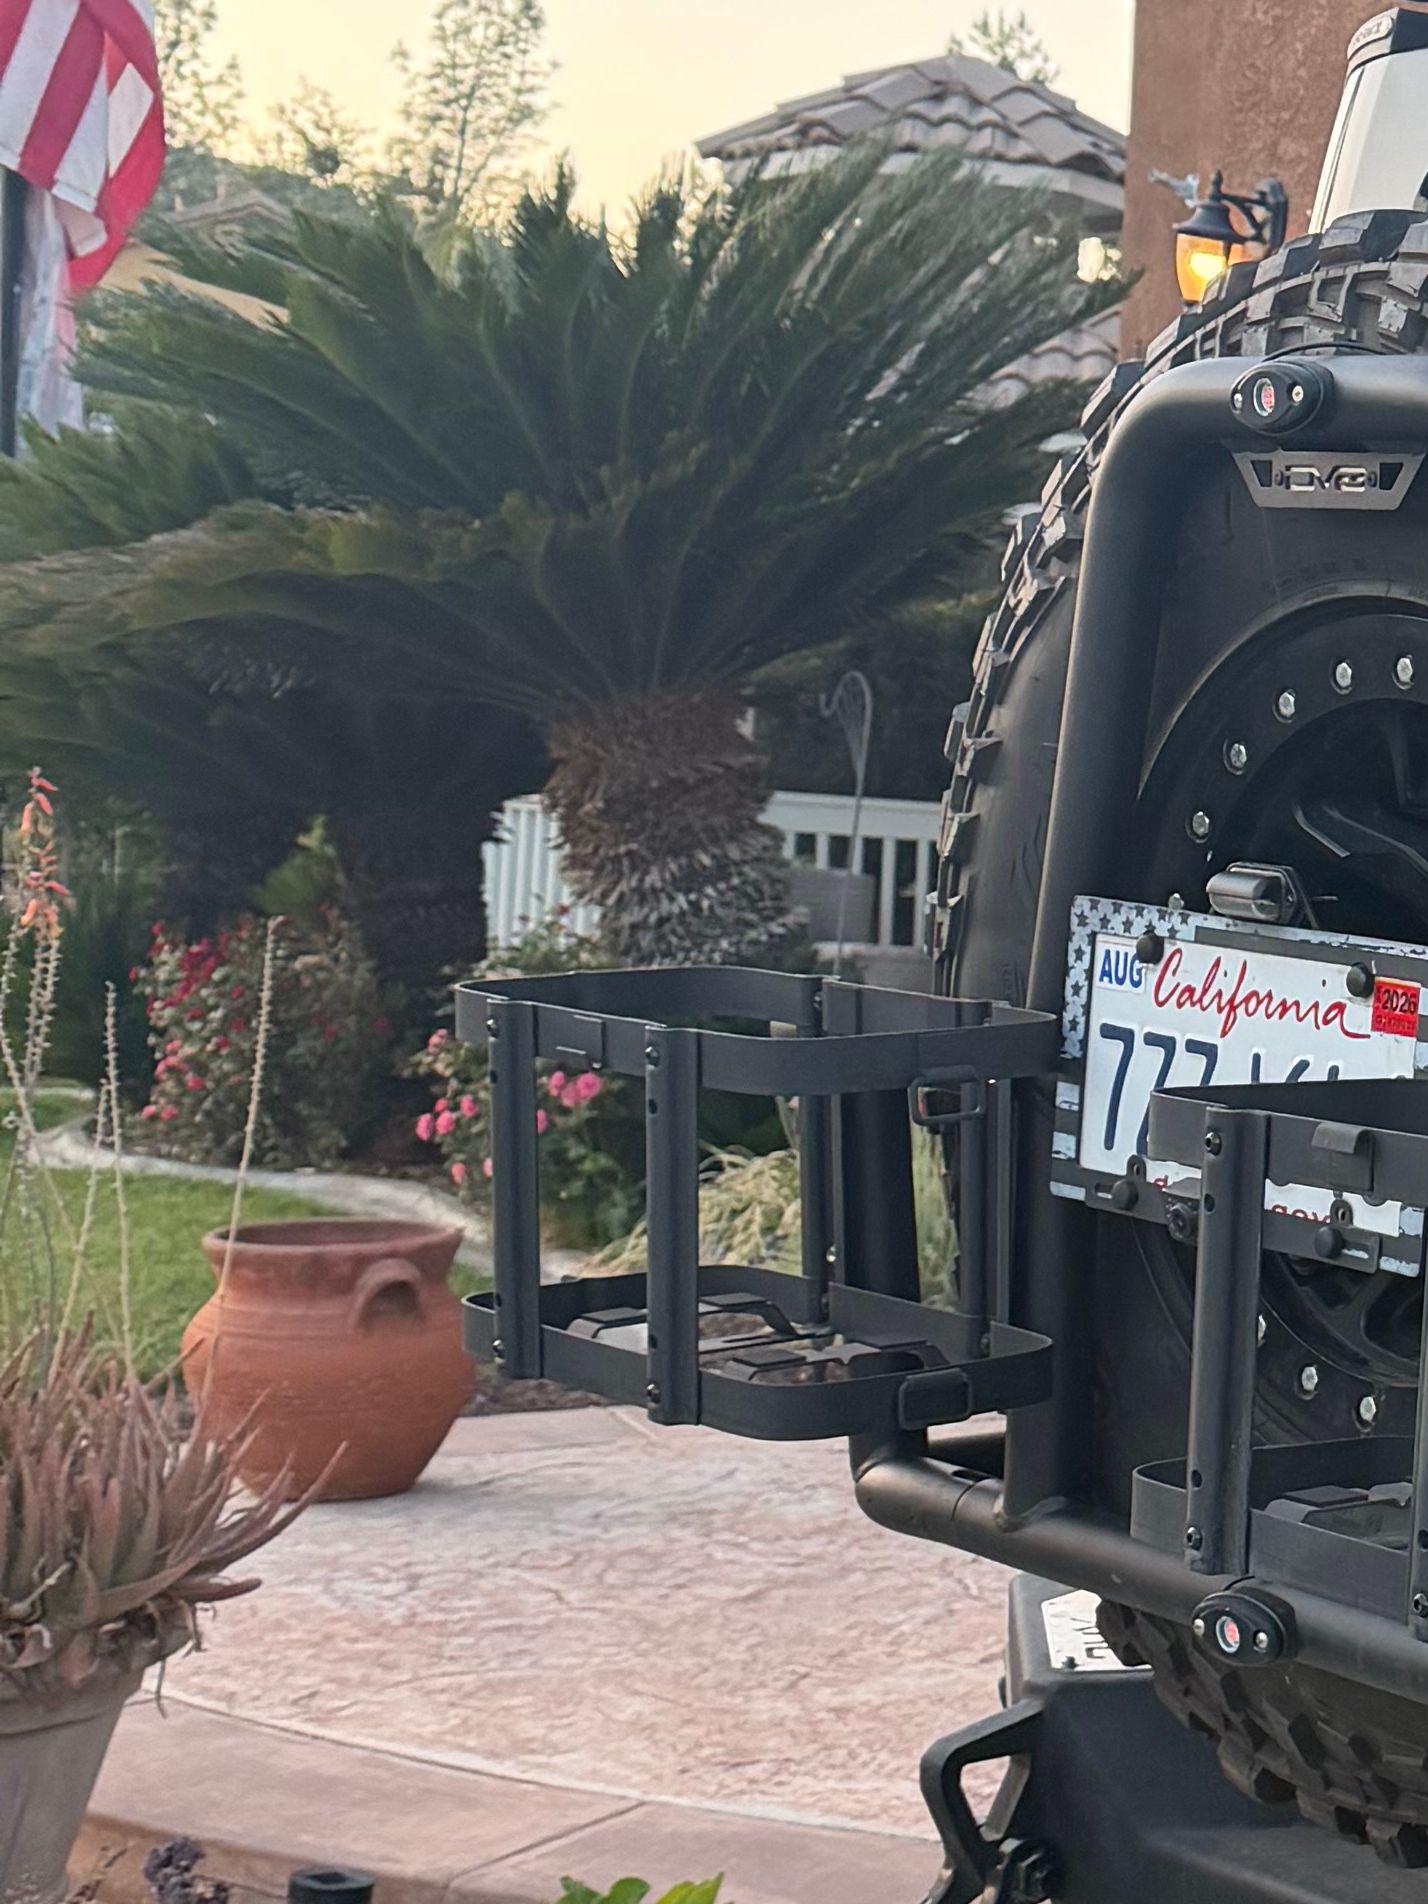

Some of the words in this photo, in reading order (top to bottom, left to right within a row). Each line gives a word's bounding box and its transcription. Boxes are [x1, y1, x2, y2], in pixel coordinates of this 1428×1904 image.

[1099, 949, 1143, 988] AUG
[1153, 947, 1372, 1039] California
[1382, 988, 1417, 1015] 2026
